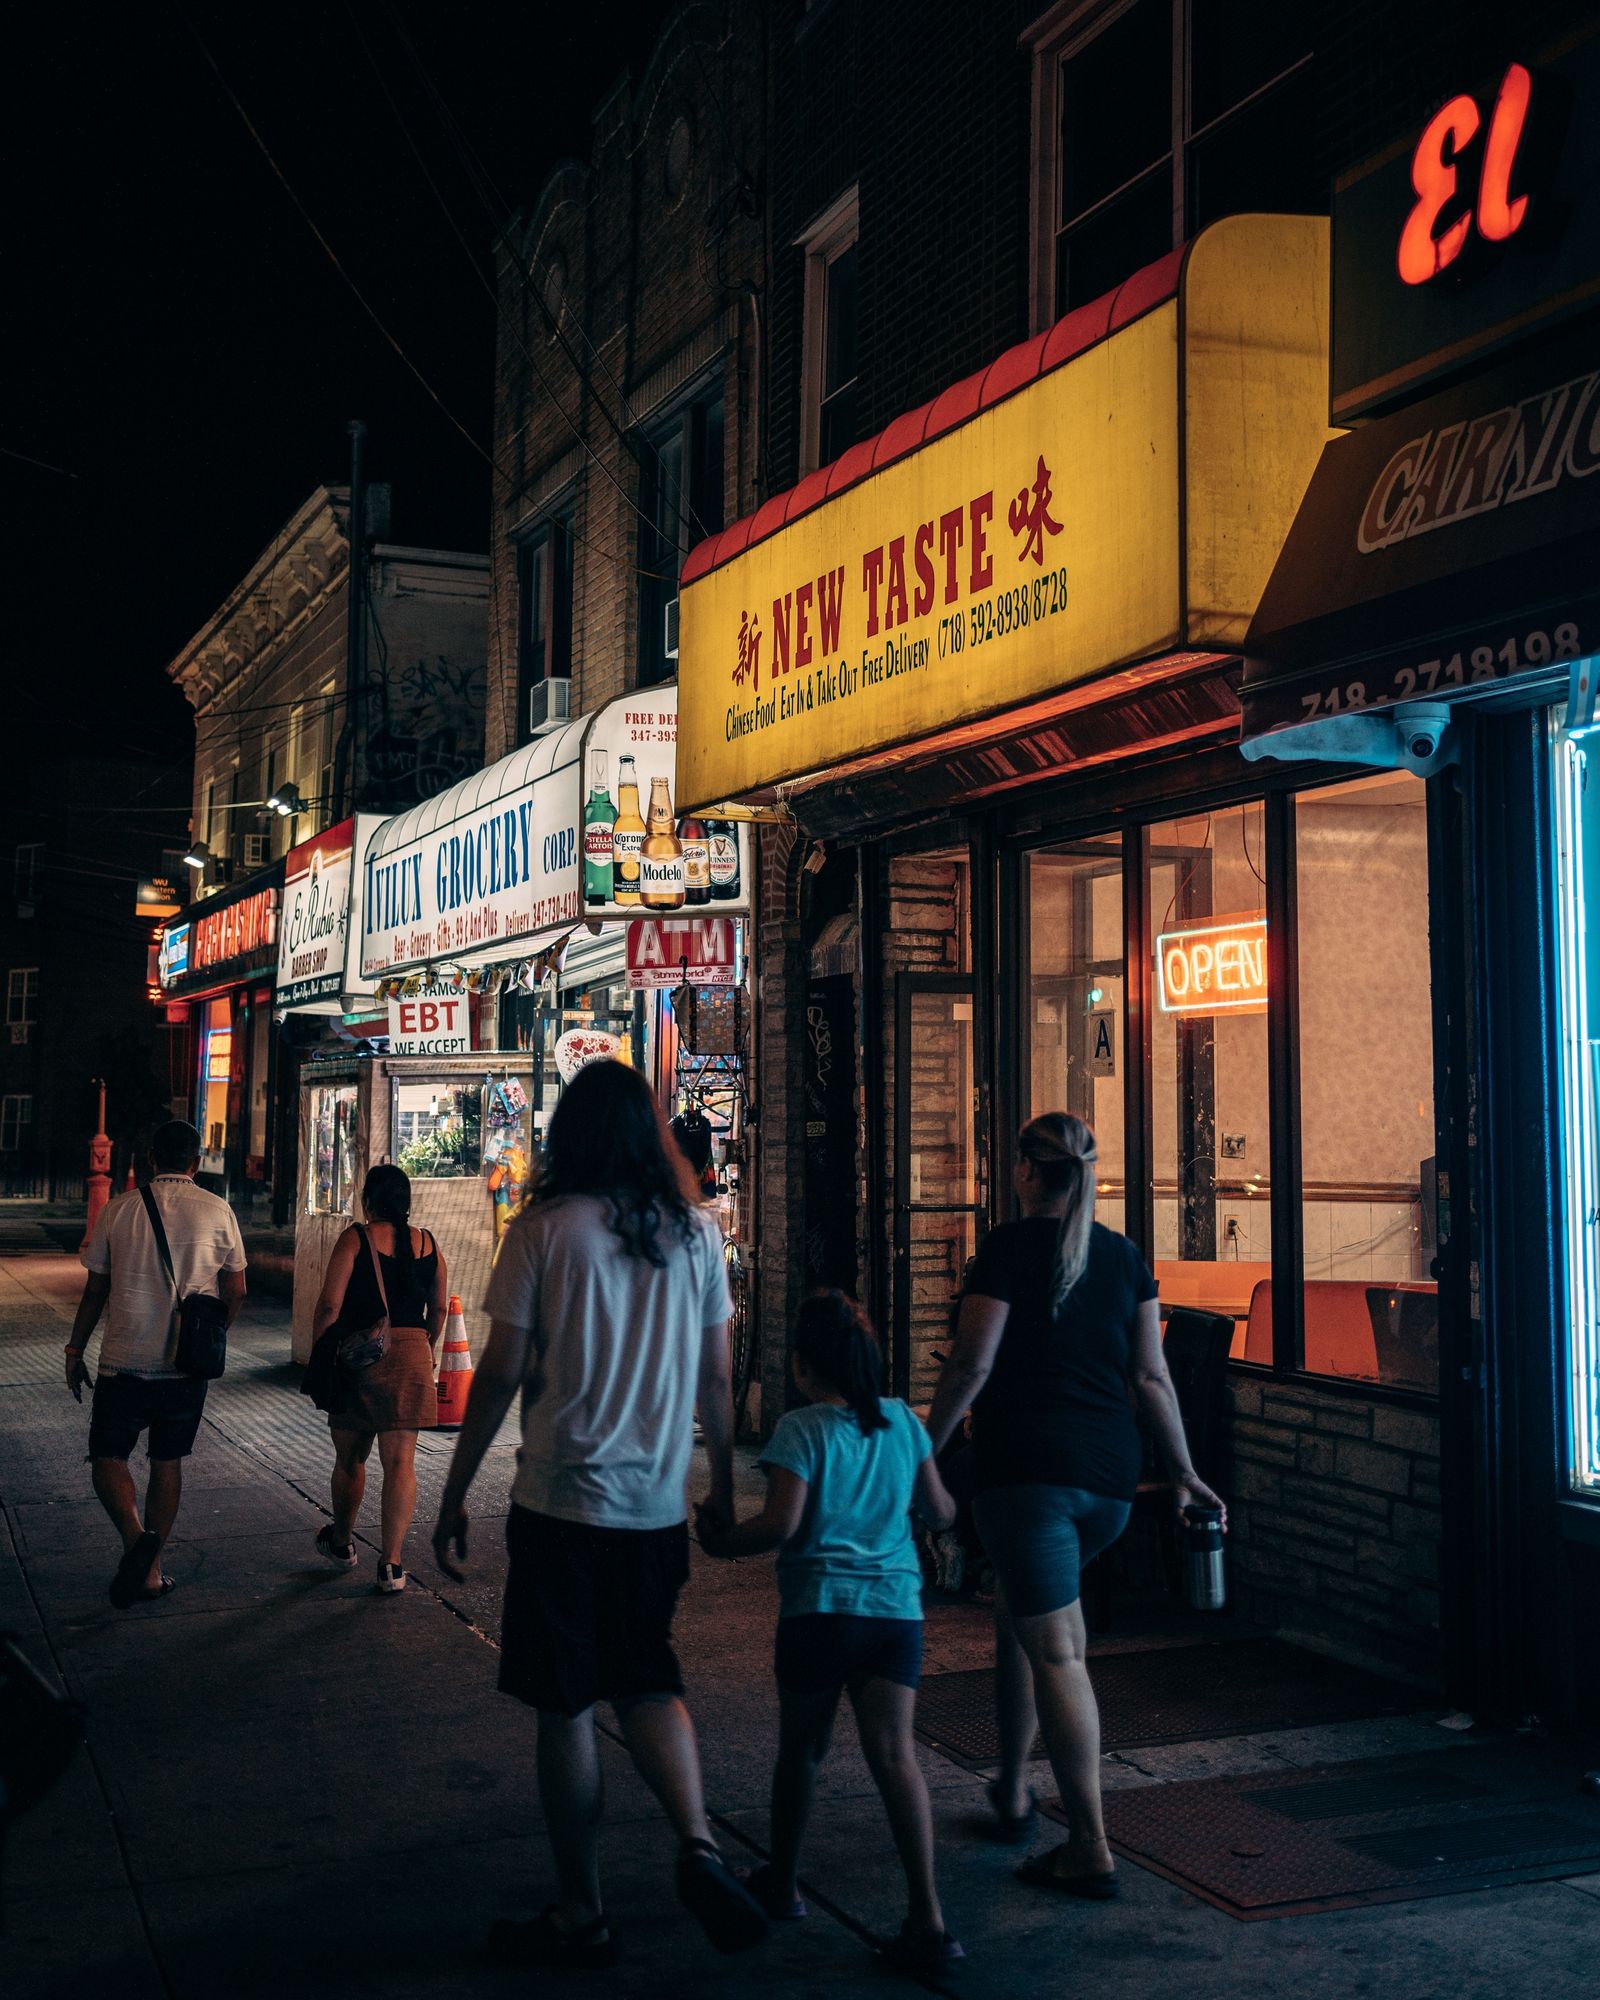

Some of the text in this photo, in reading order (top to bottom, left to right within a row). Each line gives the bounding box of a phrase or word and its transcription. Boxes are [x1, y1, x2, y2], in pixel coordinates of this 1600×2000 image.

[1396, 60, 1532, 286] El
[1008, 454, 1064, 566] 味
[772, 490, 993, 679] NEW TASTE
[938, 567, 1067, 661] (718) 592-8938/8728
[732, 610, 763, 692] 新
[755, 687, 776, 730] Food
[781, 685, 795, 720] Eat
[806, 674, 814, 711] &
[817, 664, 836, 707] Take
[839, 660, 857, 698] Out
[862, 649, 883, 687] Free
[886, 632, 930, 678] Delivery
[625, 713, 654, 724] FREE
[436, 800, 533, 914] GROCERY
[543, 827, 577, 874] CORP.
[643, 864, 682, 880] Modelo
[710, 856, 736, 864] UINNESS
[394, 935, 406, 962] Beer
[410, 930, 432, 959] Grocery
[437, 918, 450, 952] Gifts
[470, 906, 482, 942] And
[483, 903, 498, 938] Plus
[505, 909, 529, 937] Delivery
[636, 919, 725, 966] ATM
[291, 947, 327, 979] BARBER SHOP
[1166, 938, 1265, 995] OPEN
[400, 1001, 459, 1033] EBT
[1095, 1019, 1111, 1058] A
[395, 1038, 466, 1055] WE ACCEPT
